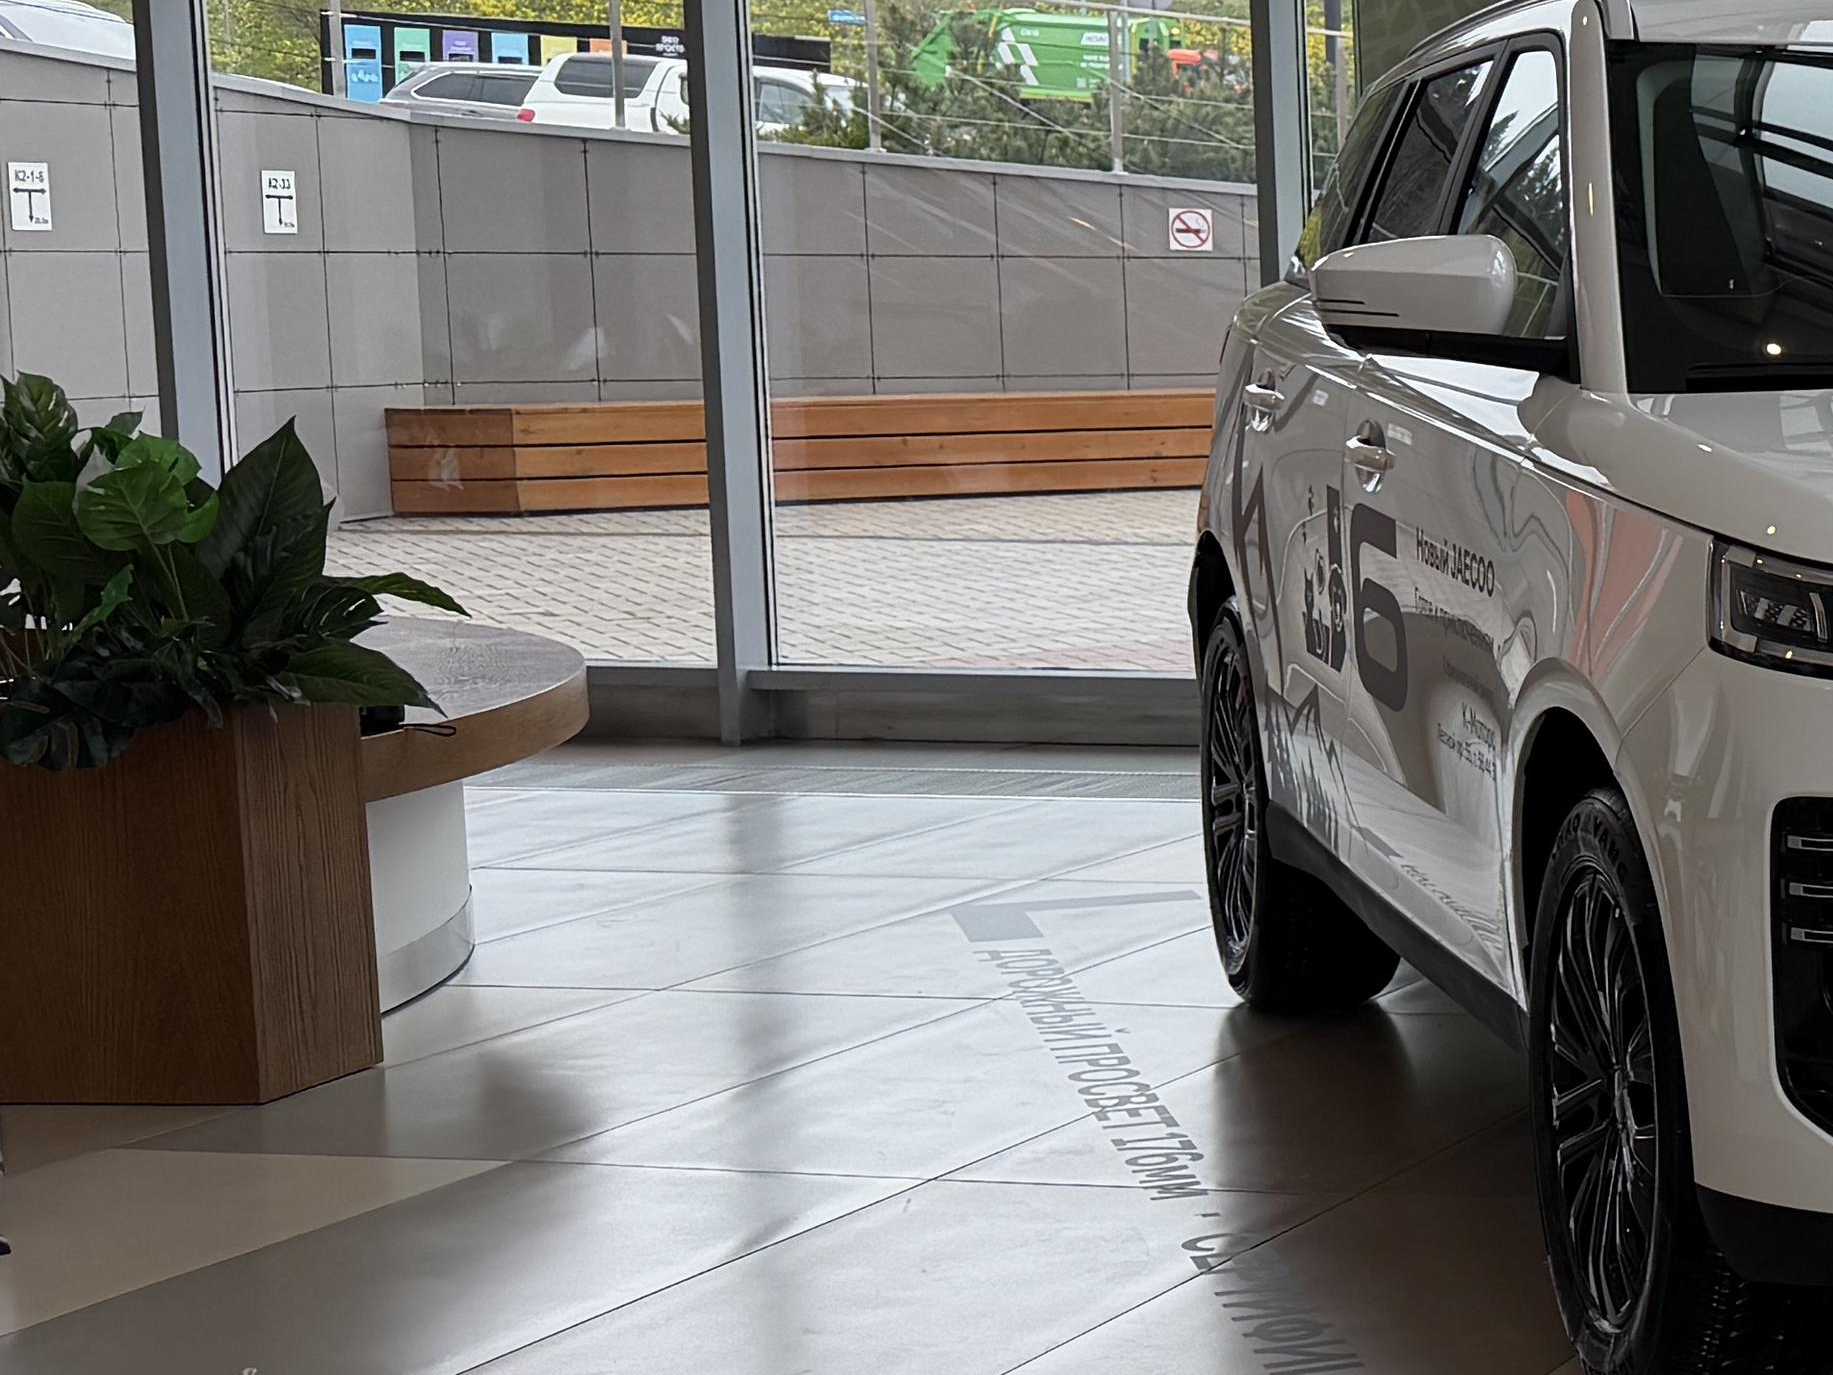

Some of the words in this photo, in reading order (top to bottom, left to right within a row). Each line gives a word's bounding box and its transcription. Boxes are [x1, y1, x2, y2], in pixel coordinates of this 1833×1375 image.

[1416, 526, 1449, 575] Новый
[1450, 542, 1495, 597] JAECOO
[972, 948, 1131, 1043] ДОРОЖНЫЙ
[1049, 1042, 1180, 1129] ПРОСВЕТ
